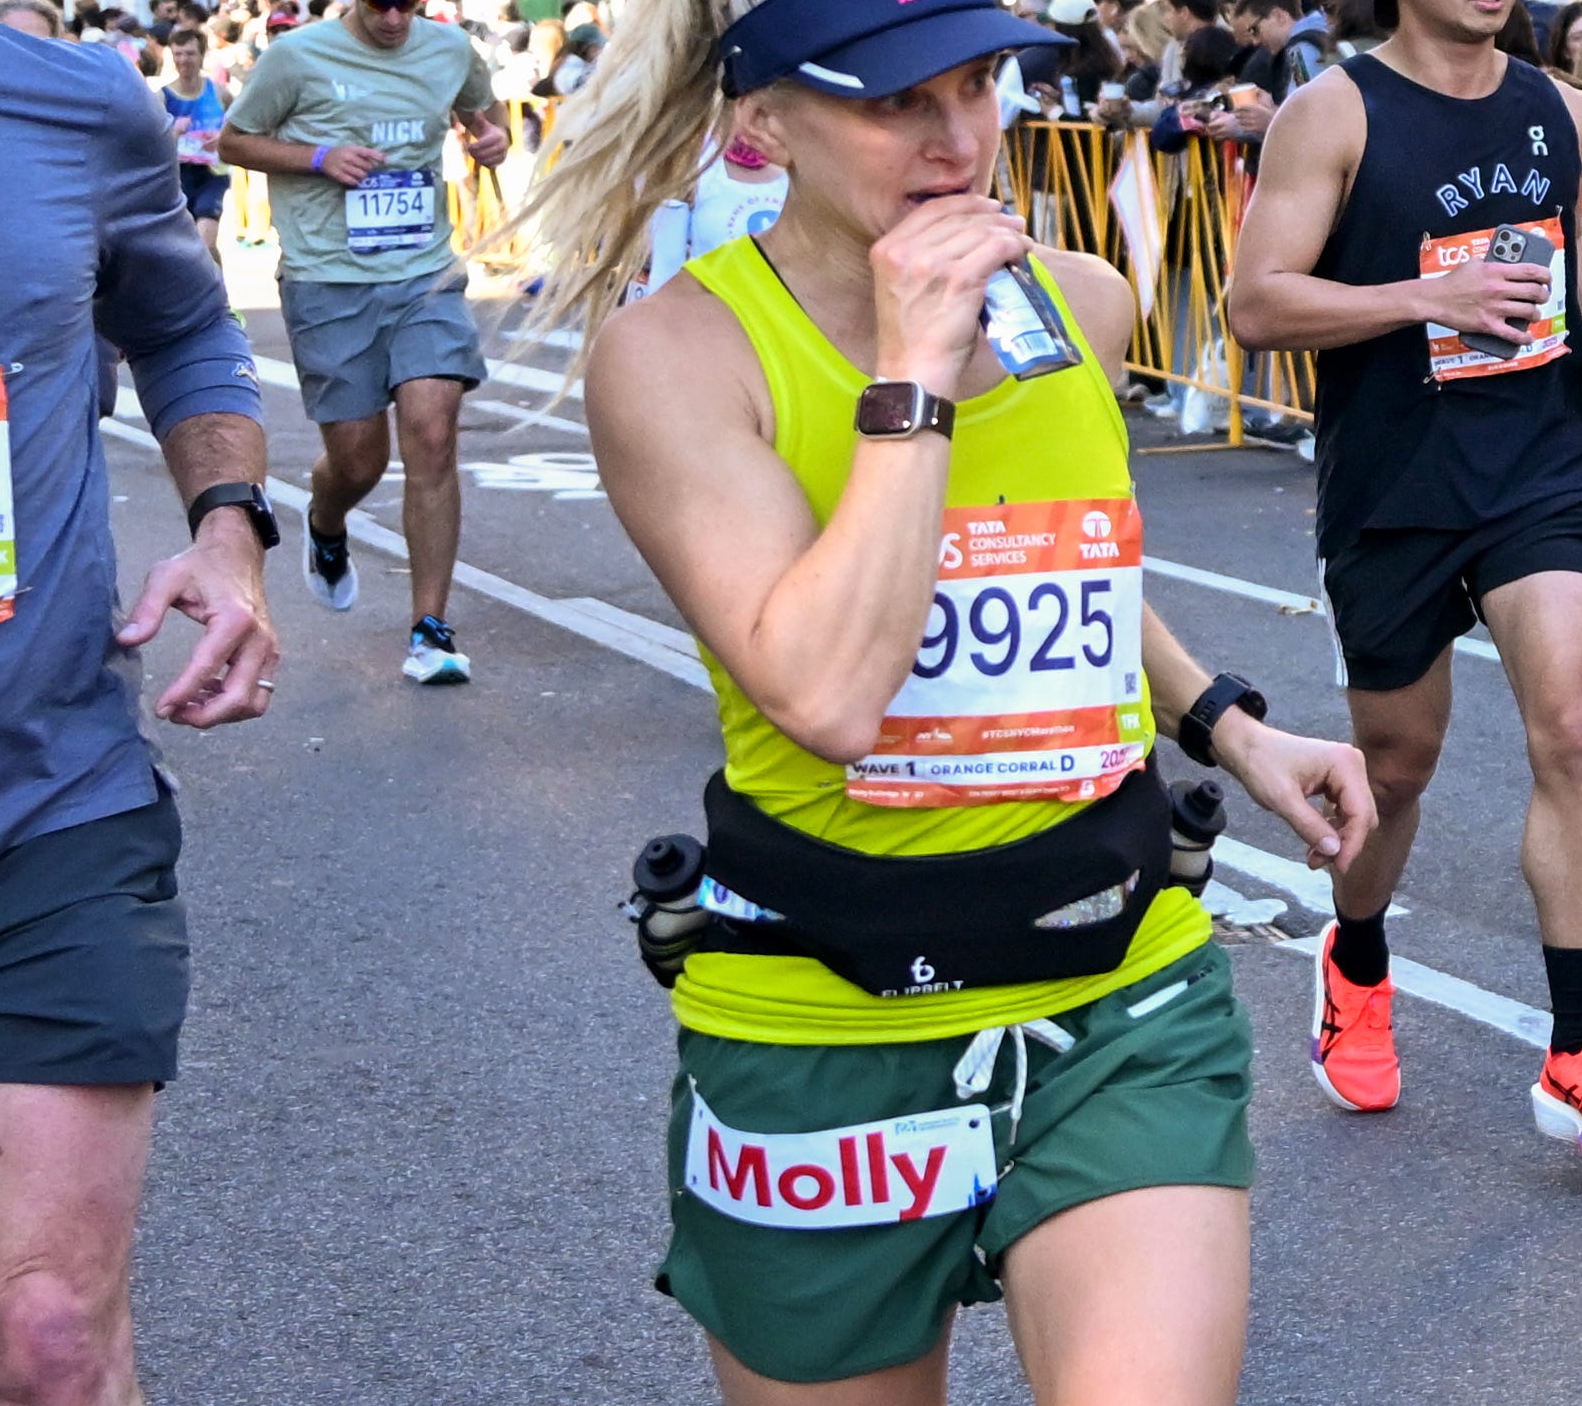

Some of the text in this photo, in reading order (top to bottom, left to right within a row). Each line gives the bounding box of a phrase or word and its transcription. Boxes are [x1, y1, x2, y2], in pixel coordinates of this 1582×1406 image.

[371, 120, 426, 144] NICK
[1436, 163, 1551, 217] RYAN
[358, 191, 425, 217] 11754
[1436, 245, 1470, 267] tcs
[968, 520, 1007, 536] TATA
[969, 533, 1057, 550] CONSULTANCY
[1079, 542, 1120, 559] TATA
[971, 550, 1028, 567] SERVICES
[912, 579, 1113, 680] 9925
[853, 761, 916, 777] WAVE 1
[931, 754, 1075, 776] ORANGE CORRAL D
[708, 1125, 948, 1223] Molly
